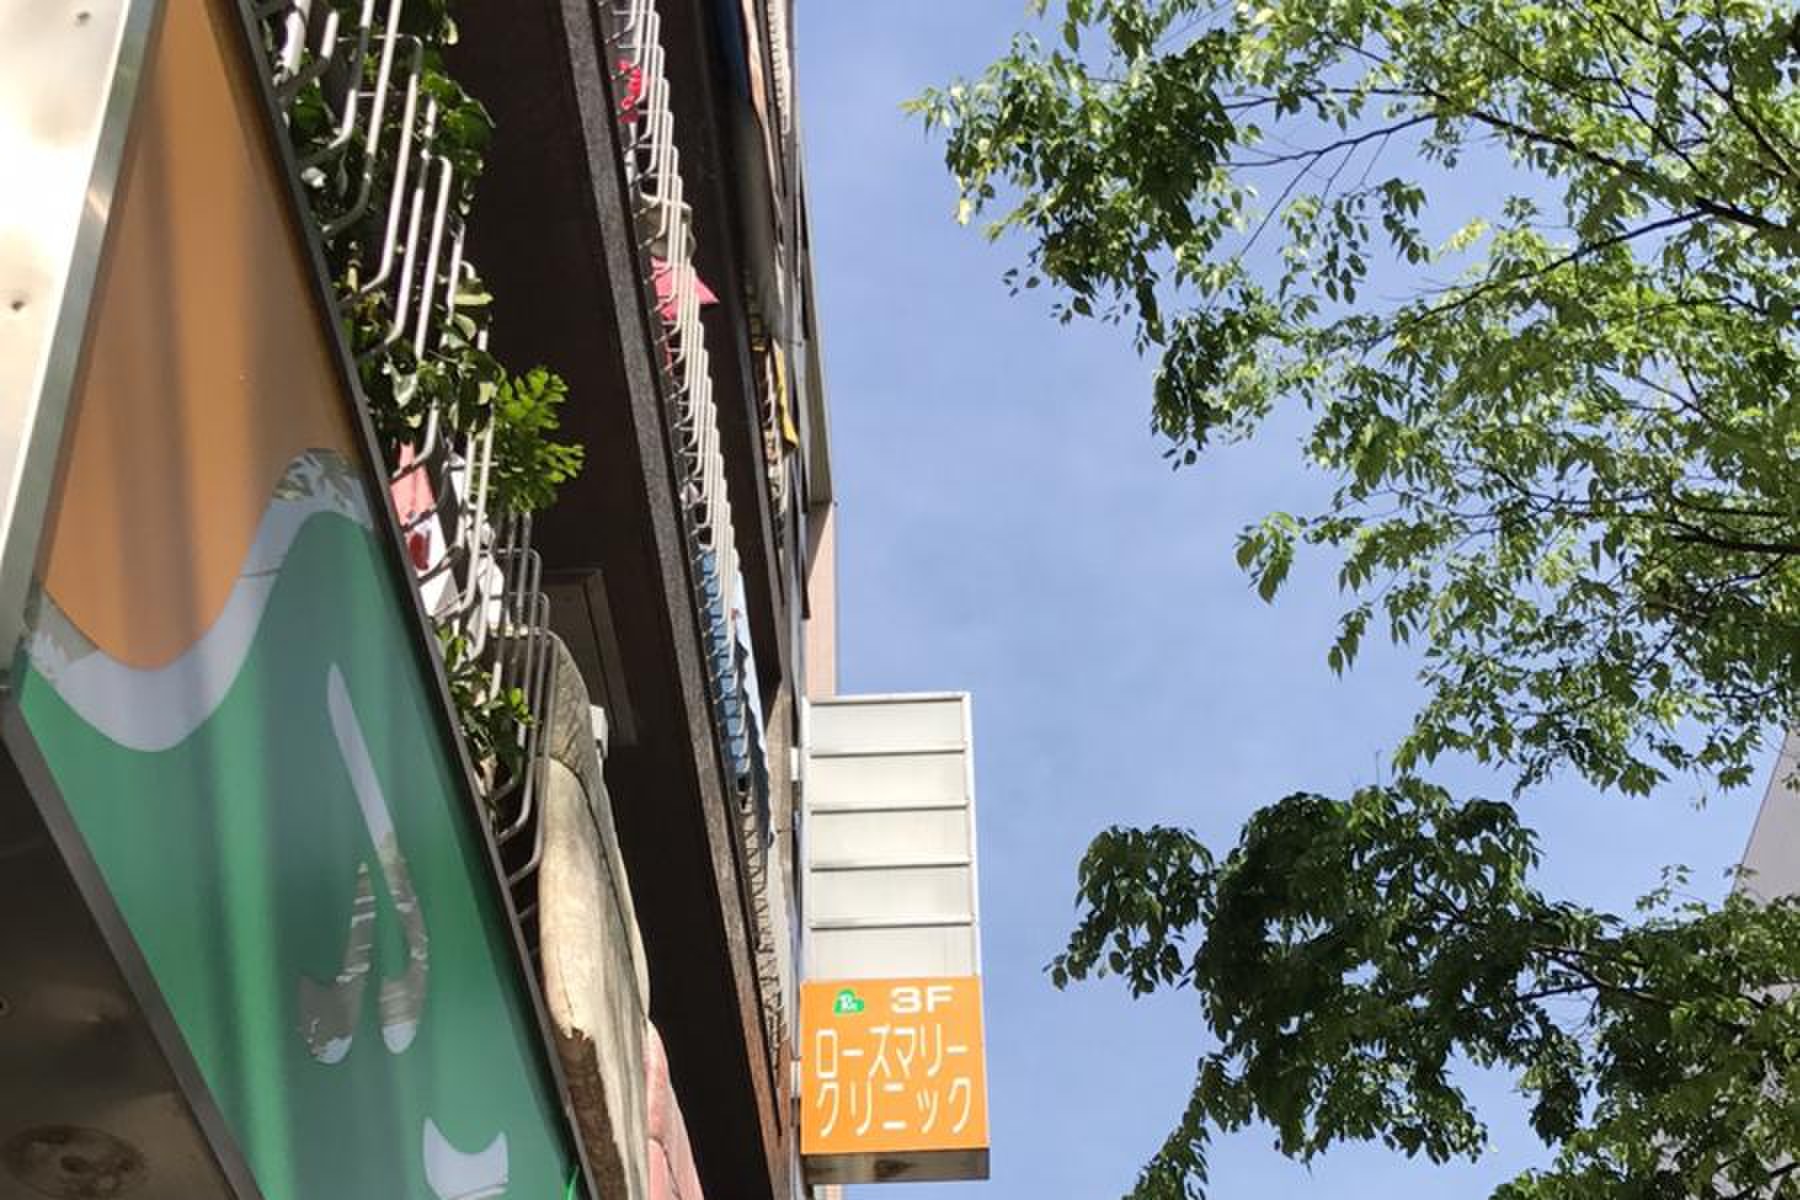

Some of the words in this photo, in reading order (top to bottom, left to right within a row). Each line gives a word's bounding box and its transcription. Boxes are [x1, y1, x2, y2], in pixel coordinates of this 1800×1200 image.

[891, 986, 954, 1014] 3F
[816, 1077, 971, 1137] クリニック
